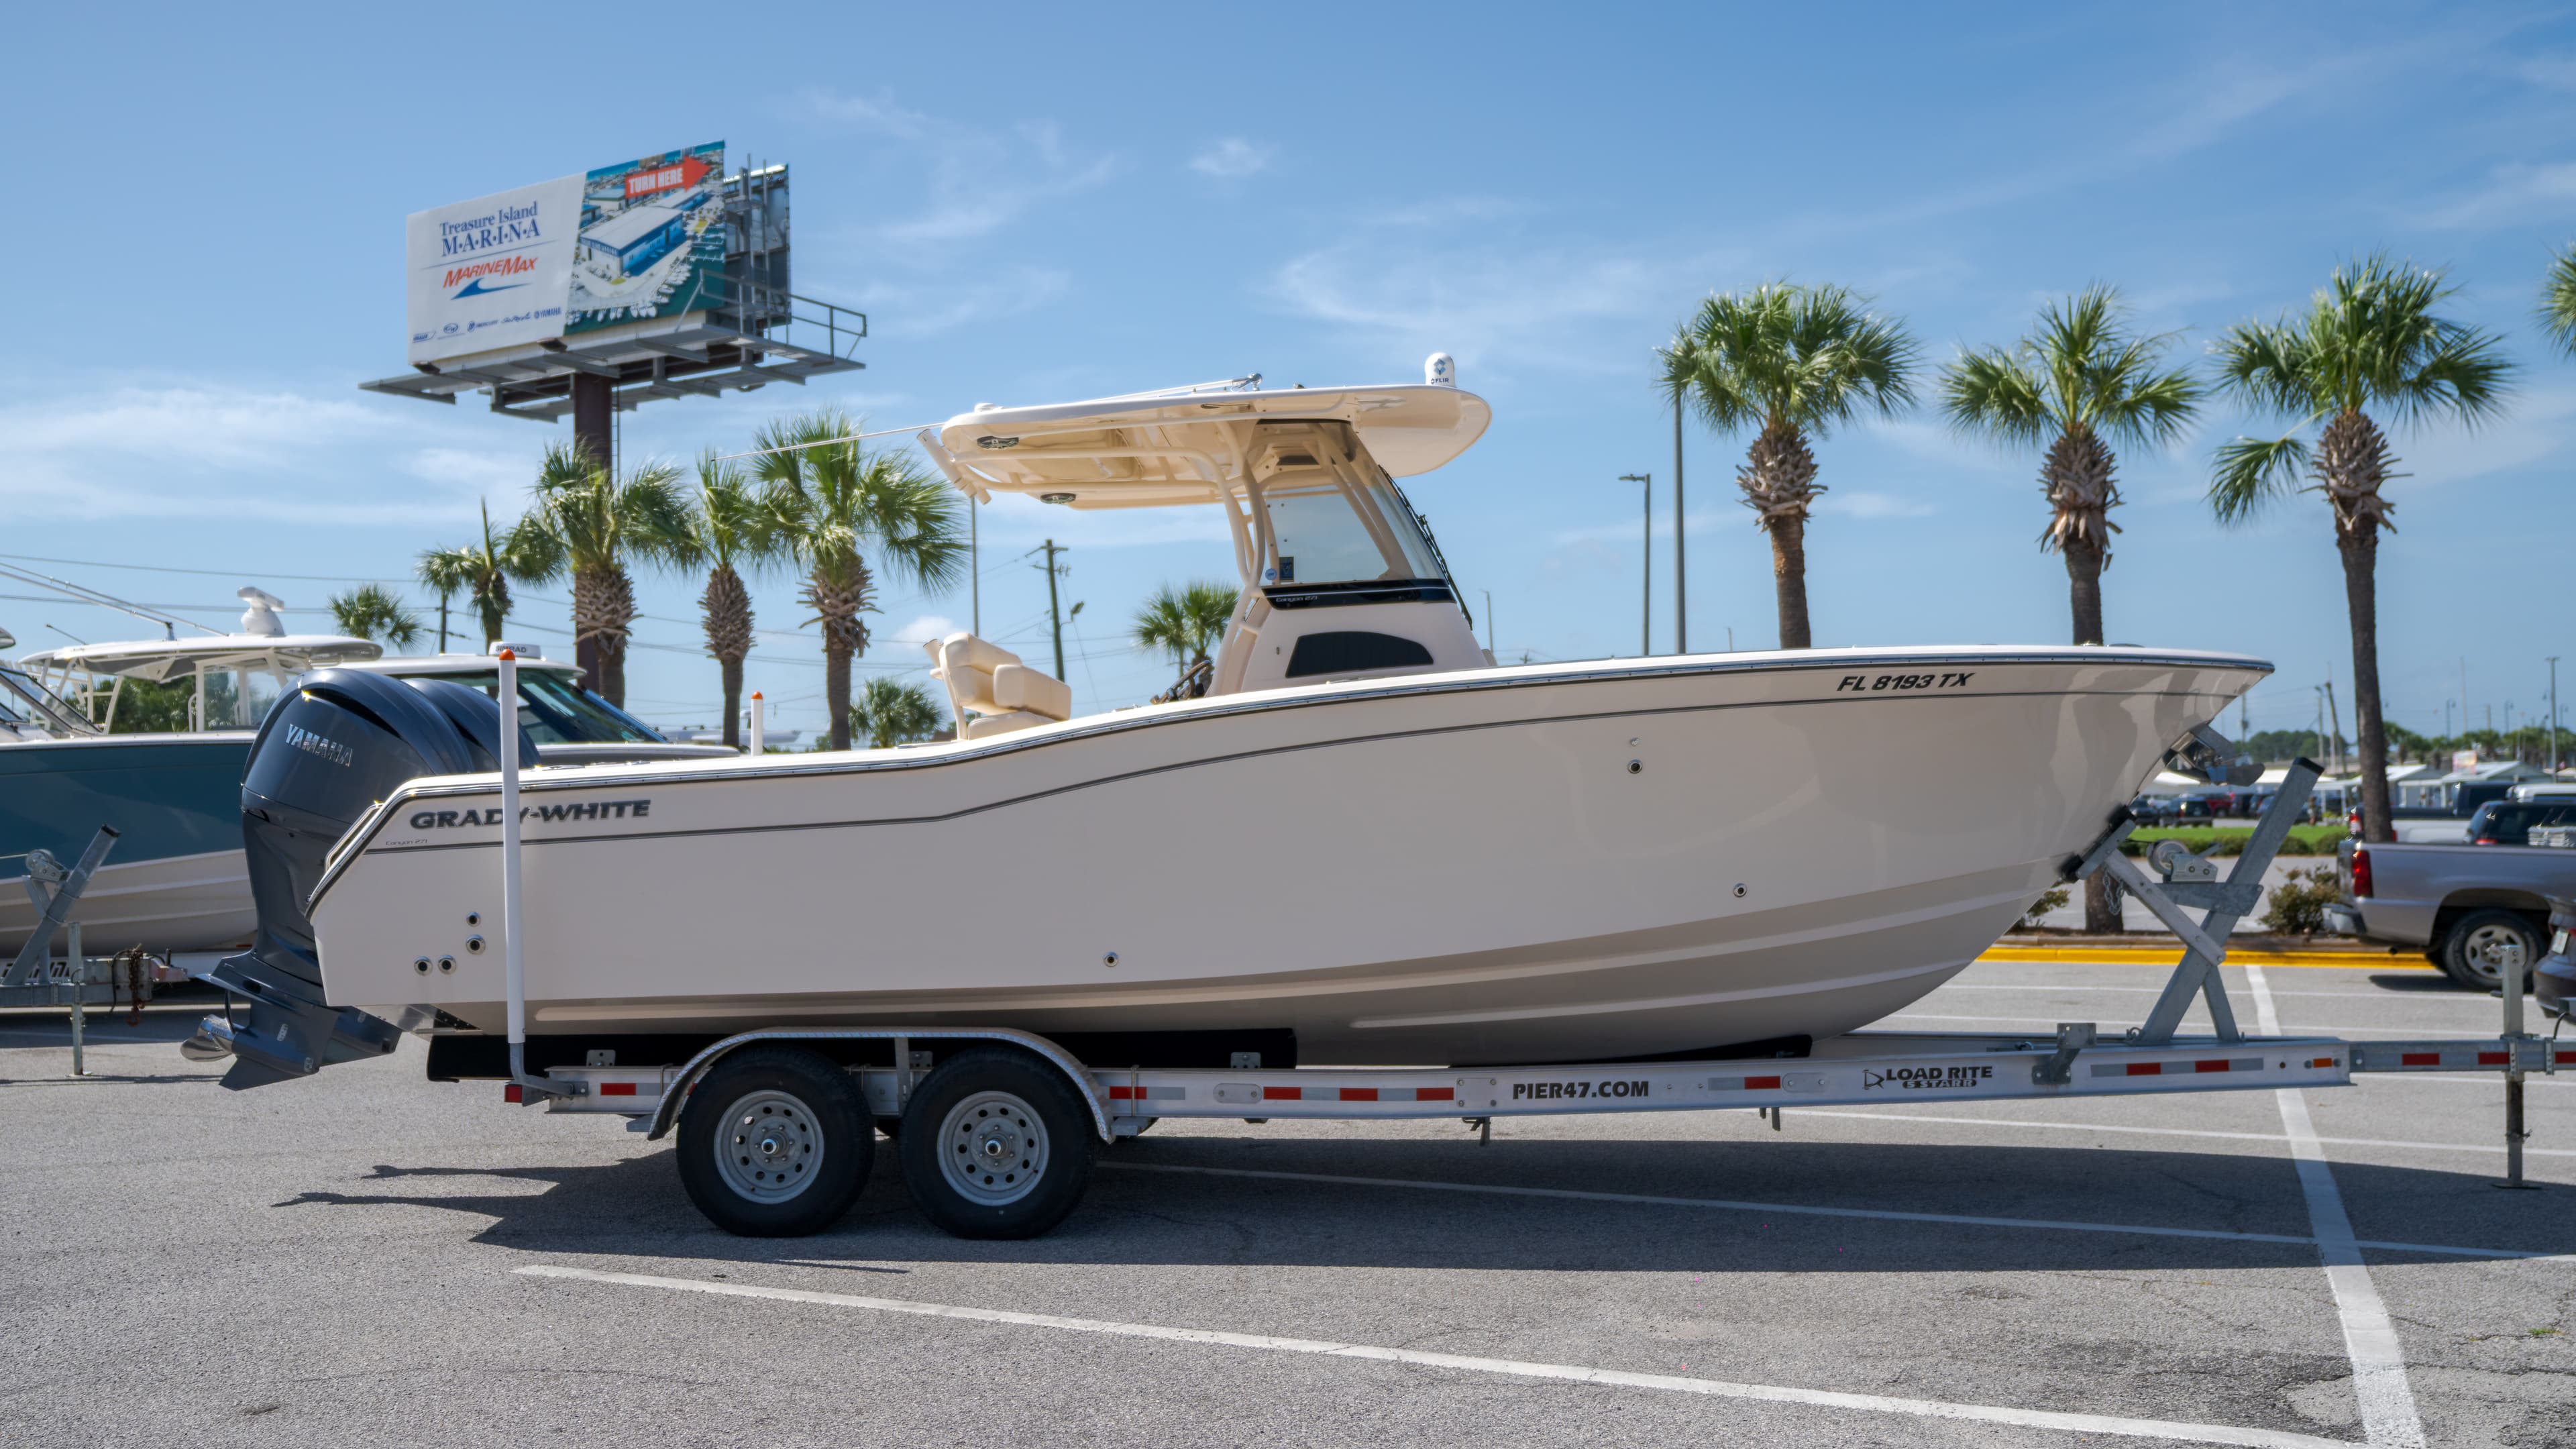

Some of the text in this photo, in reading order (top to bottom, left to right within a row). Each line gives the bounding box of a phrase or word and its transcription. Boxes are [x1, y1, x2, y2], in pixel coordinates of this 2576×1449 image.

[629, 168, 683, 194] TURN HERE
[440, 201, 538, 236] Treasure Island
[539, 307, 561, 318] YAMAHA
[1837, 673, 1975, 692] FL 8193 TX
[286, 724, 353, 767] YAMAHA
[1886, 1066, 1992, 1081] LOAD RITE
[1920, 1079, 1973, 1087] STARR
[1513, 1081, 1649, 1100] PIER47.COM
